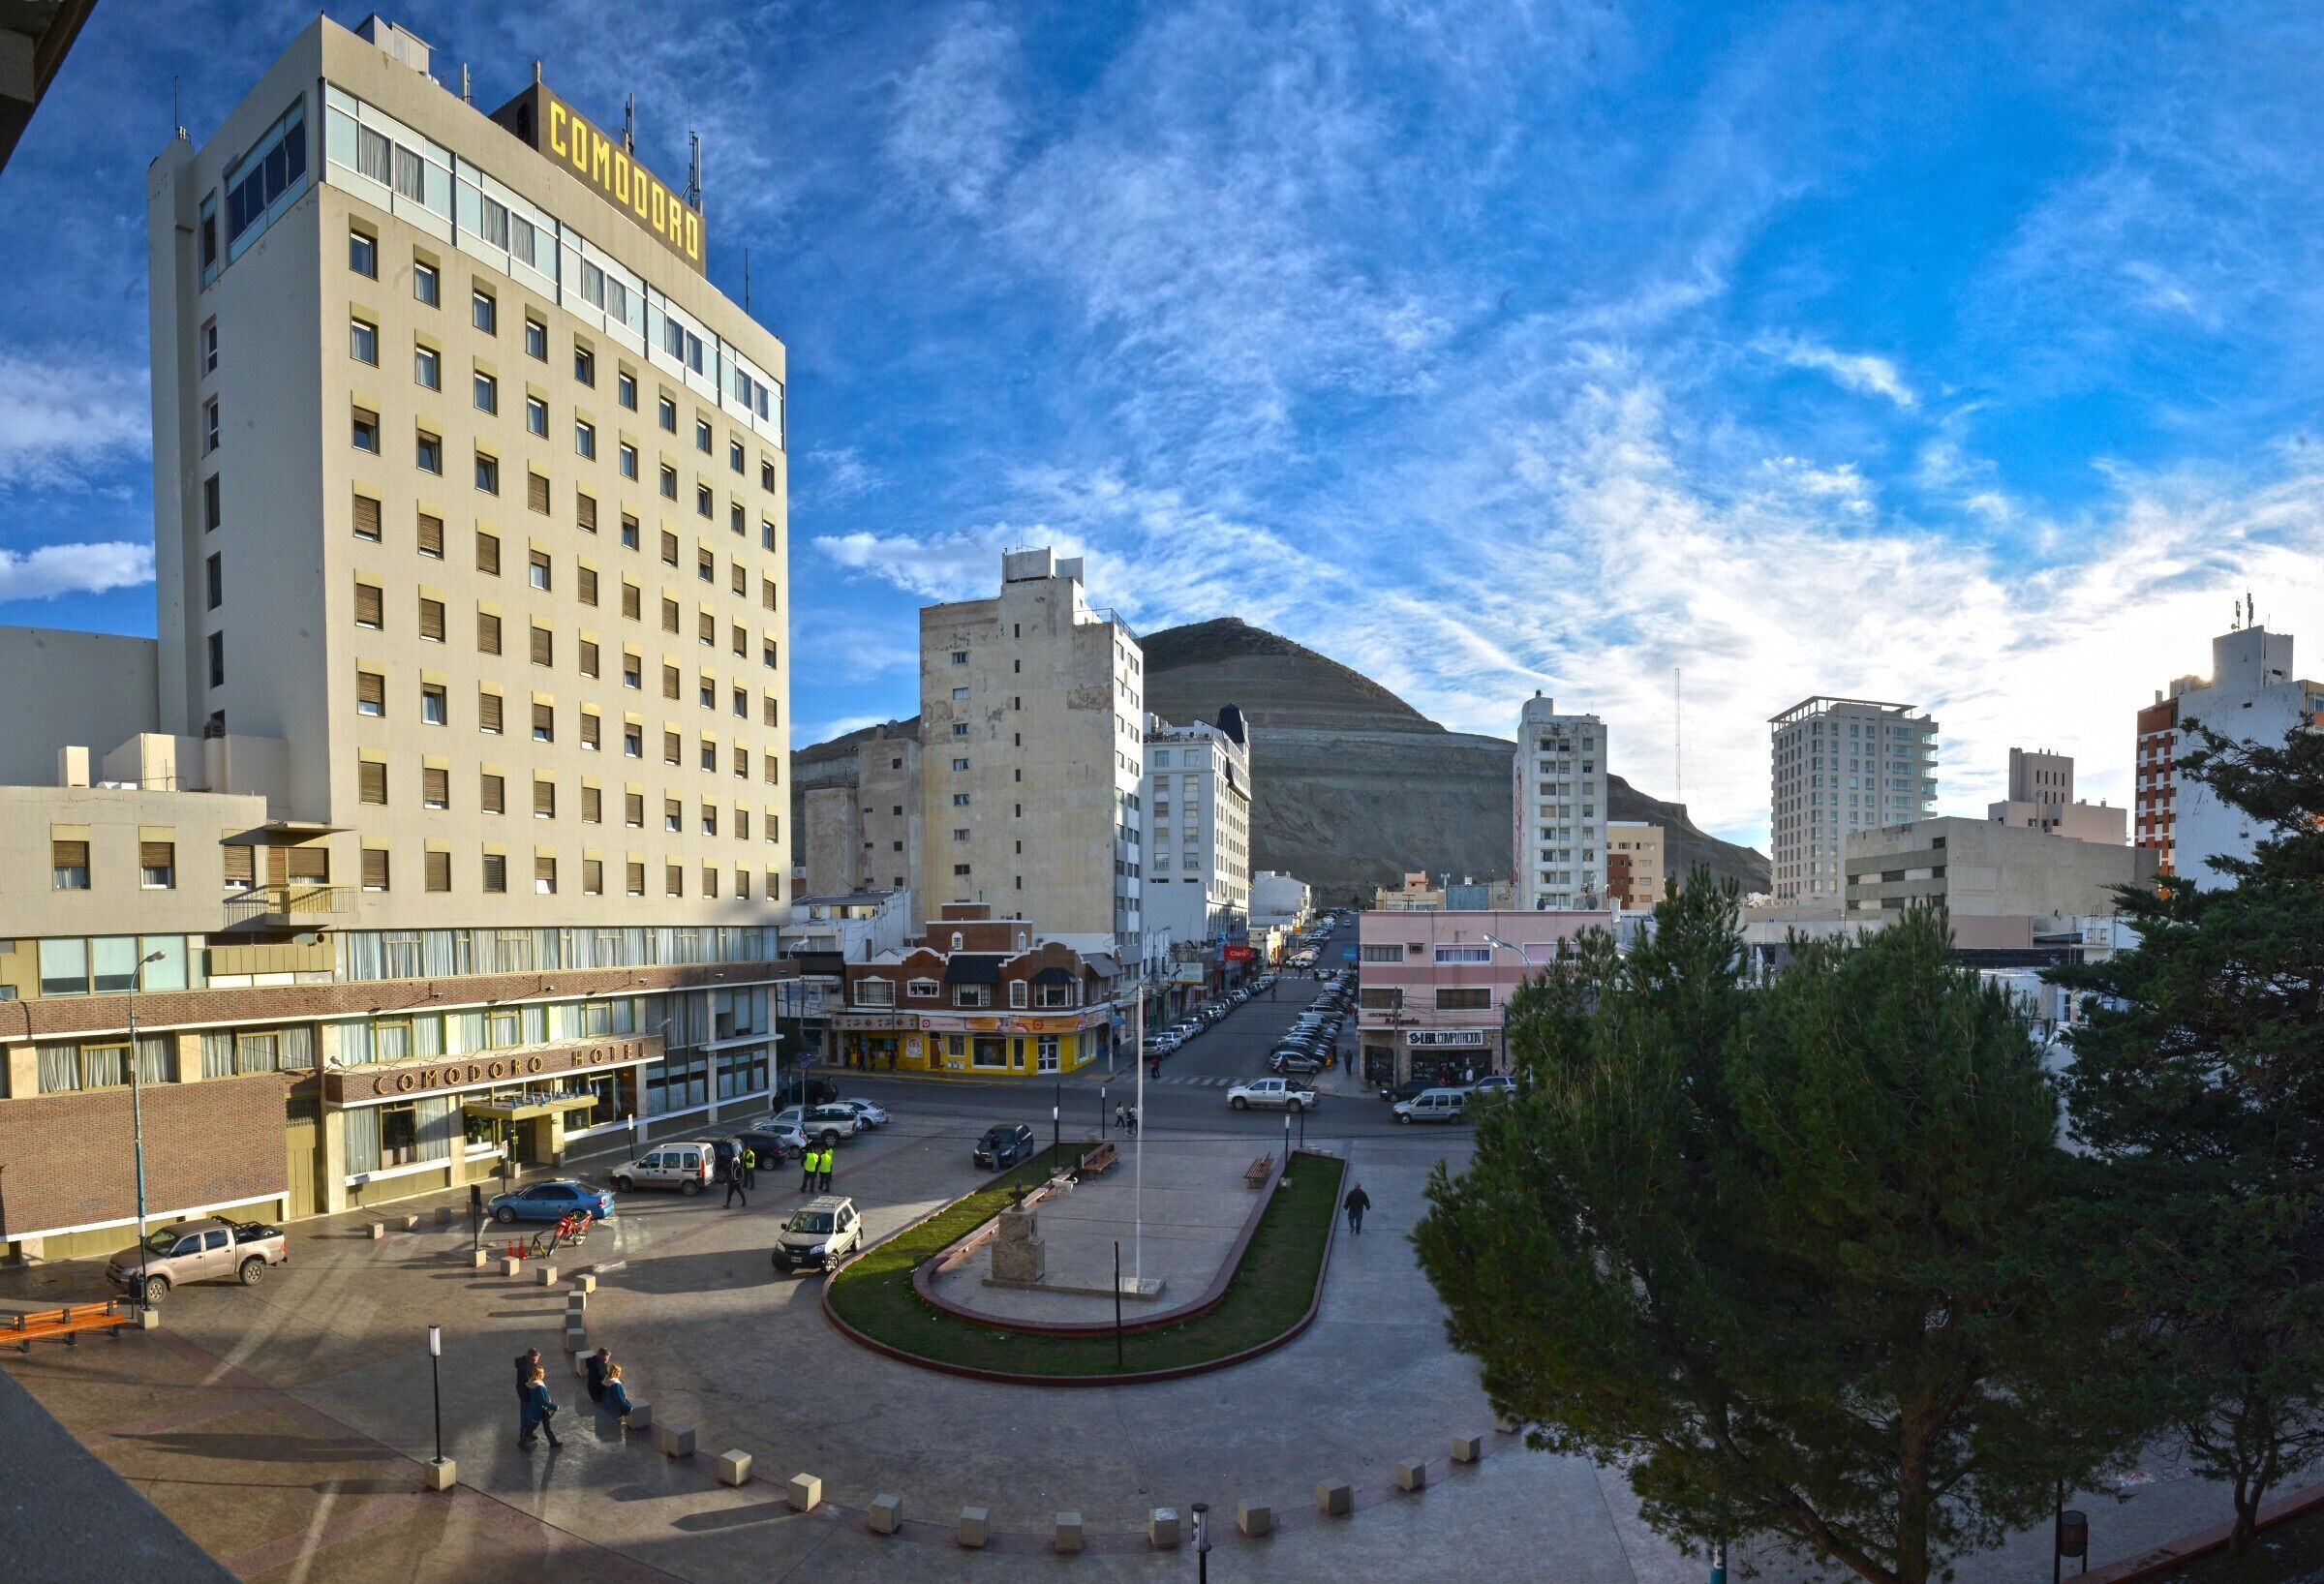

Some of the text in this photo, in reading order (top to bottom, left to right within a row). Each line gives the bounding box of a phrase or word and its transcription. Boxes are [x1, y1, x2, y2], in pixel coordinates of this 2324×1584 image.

[551, 101, 697, 260] COMODORO
[1437, 1032, 1482, 1045] COMPUTACION
[374, 1042, 646, 1095] COMODORO HOTEL
